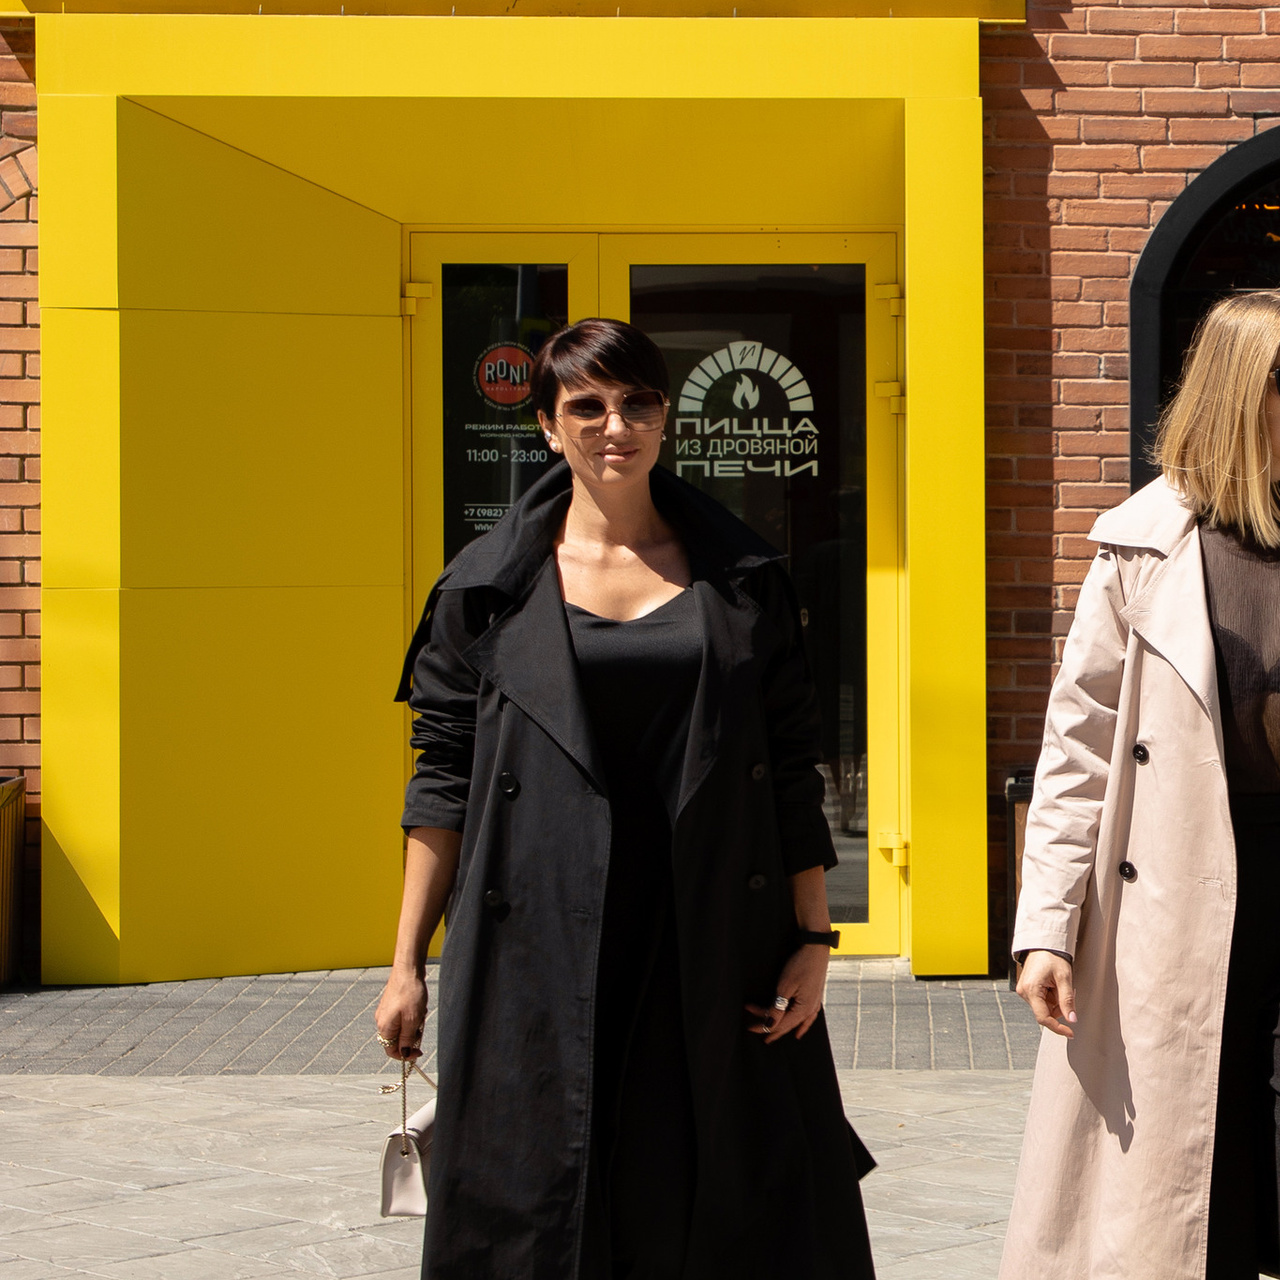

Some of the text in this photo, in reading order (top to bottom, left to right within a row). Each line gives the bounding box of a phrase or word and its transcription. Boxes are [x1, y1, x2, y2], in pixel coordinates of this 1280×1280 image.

[485, 358, 528, 385] RONI
[464, 423, 542, 431] РЕЖИМ РАБОТ
[675, 417, 820, 438] ПИЦЦА
[676, 434, 818, 459] ИЗ ДРОВЯНОЙ
[466, 449, 499, 462] 11:00
[511, 449, 548, 463] 23:00
[676, 460, 819, 477] ПЕЧИ
[464, 508, 475, 517] +7
[476, 507, 503, 517] (982)
